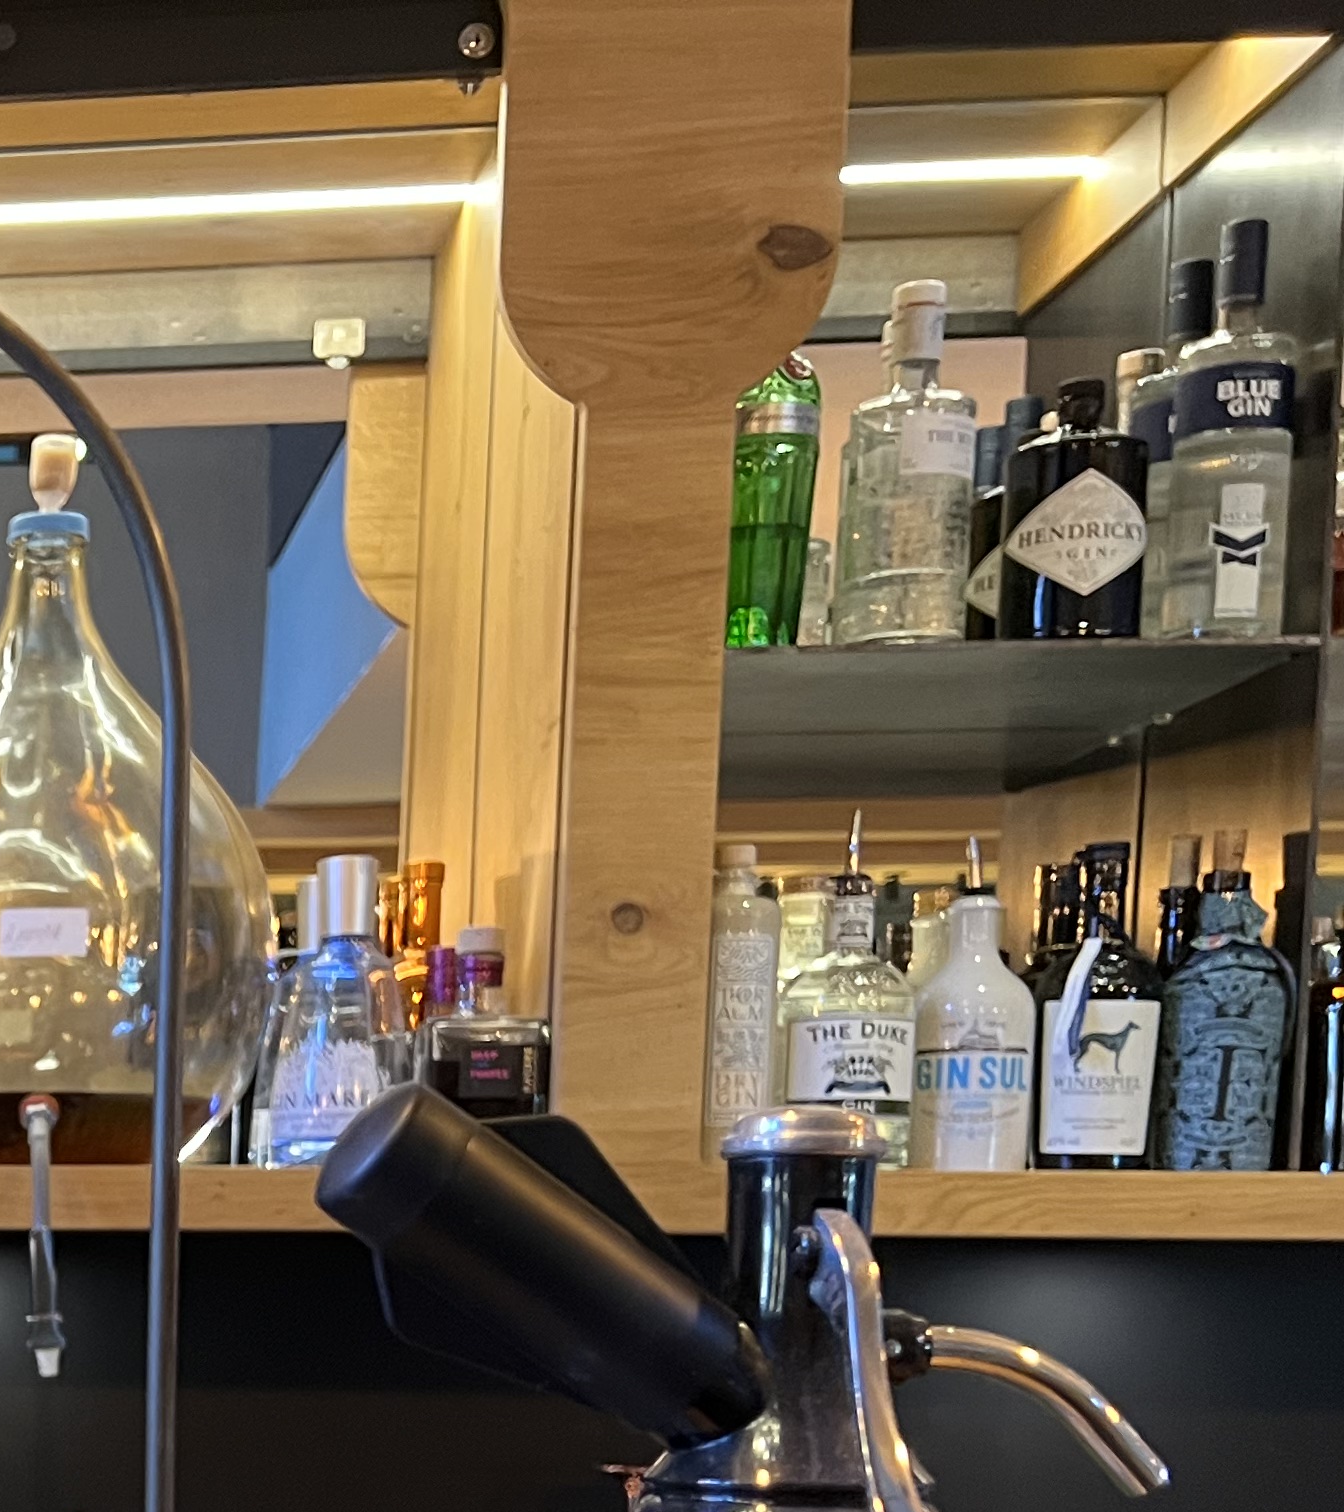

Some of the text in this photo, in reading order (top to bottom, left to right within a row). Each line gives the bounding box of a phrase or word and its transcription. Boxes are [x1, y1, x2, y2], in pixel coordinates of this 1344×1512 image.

[1216, 379, 1281, 401] BLUE
[1226, 396, 1272, 417] GIN
[806, 1021, 908, 1046] THE DUKE
[916, 1055, 1028, 1093] GIN SUL
